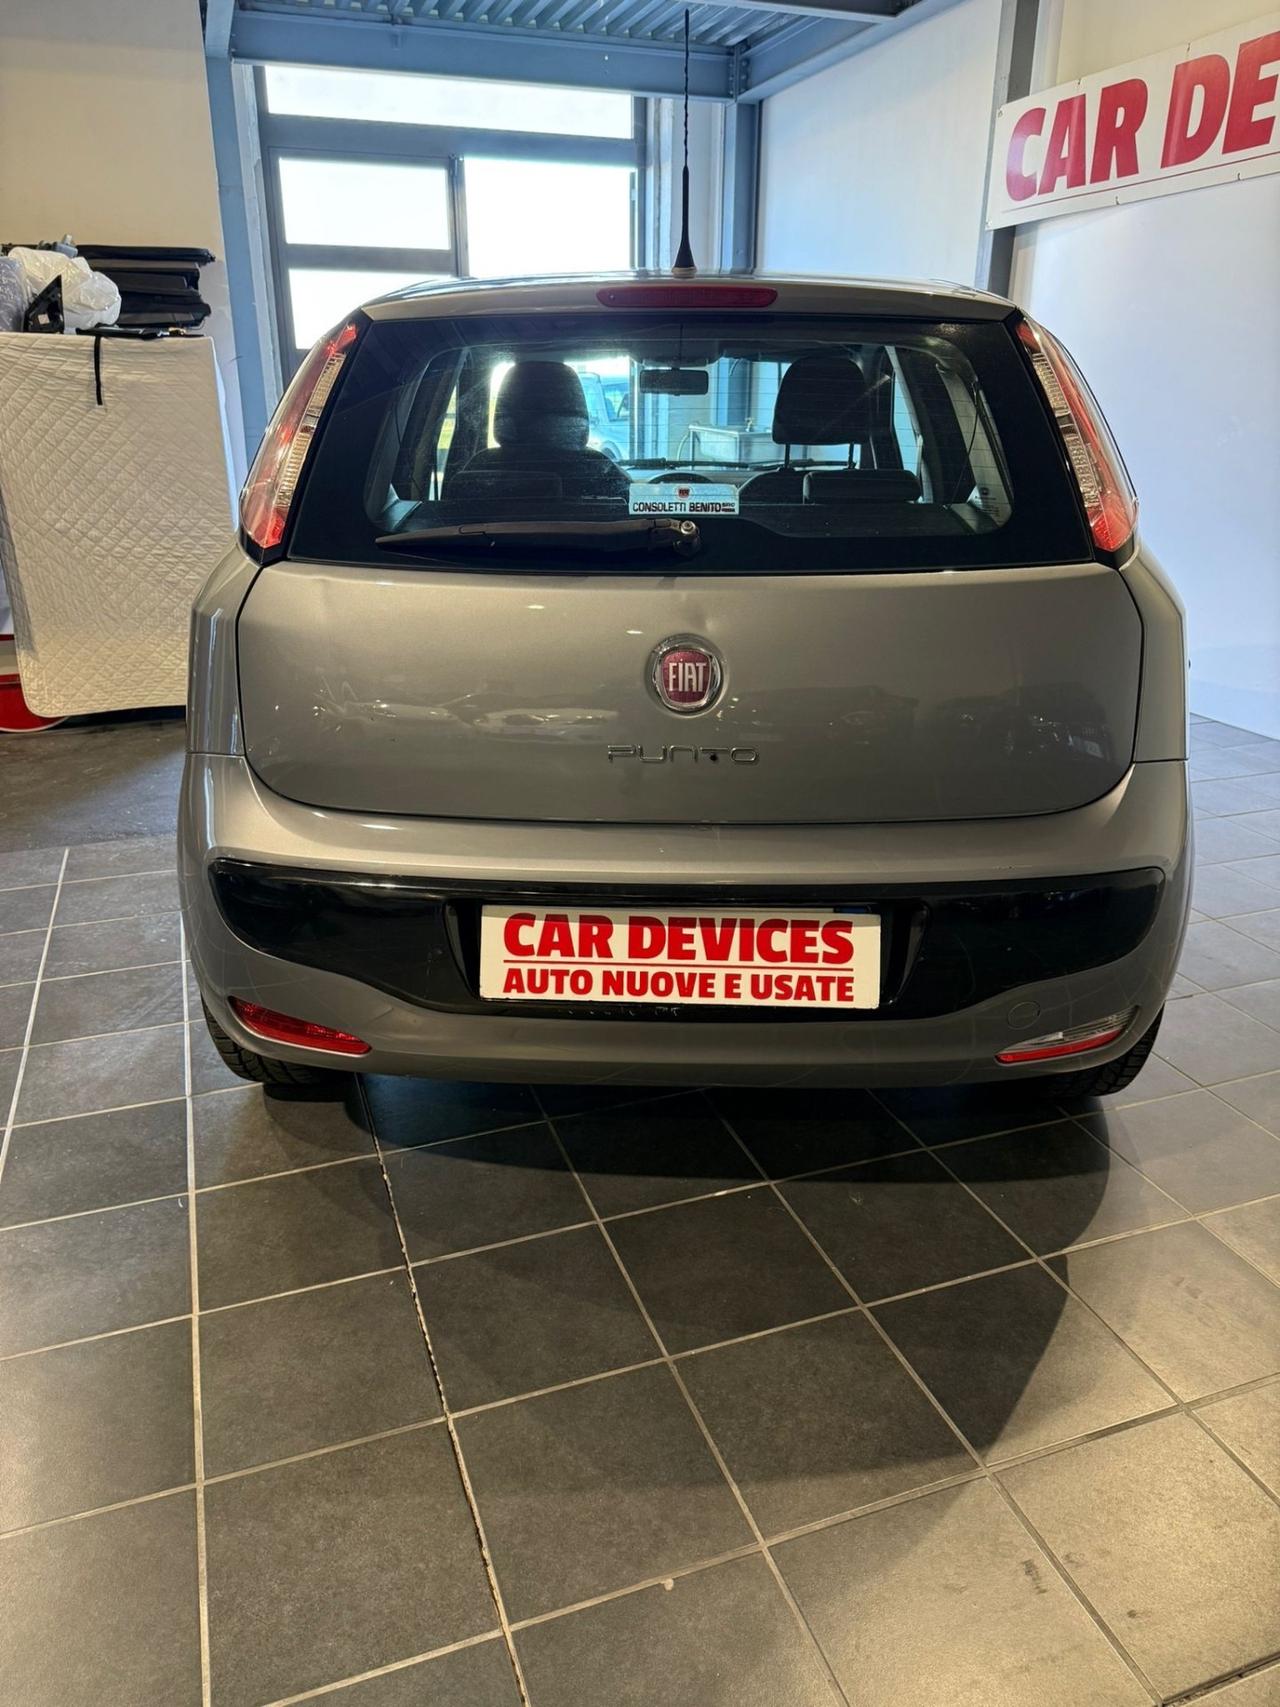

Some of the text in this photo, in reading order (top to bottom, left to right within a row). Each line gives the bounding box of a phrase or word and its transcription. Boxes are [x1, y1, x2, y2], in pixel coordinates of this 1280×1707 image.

[1006, 78, 1148, 201] CAR
[632, 502, 687, 512] CONSOLETTI
[689, 502, 721, 513] BENITO
[668, 662, 707, 692] FIAT
[608, 745, 759, 763] PUNTO
[503, 912, 854, 964] CAR DEVICES
[503, 968, 854, 1002] AUTO NUOVE E USATE
